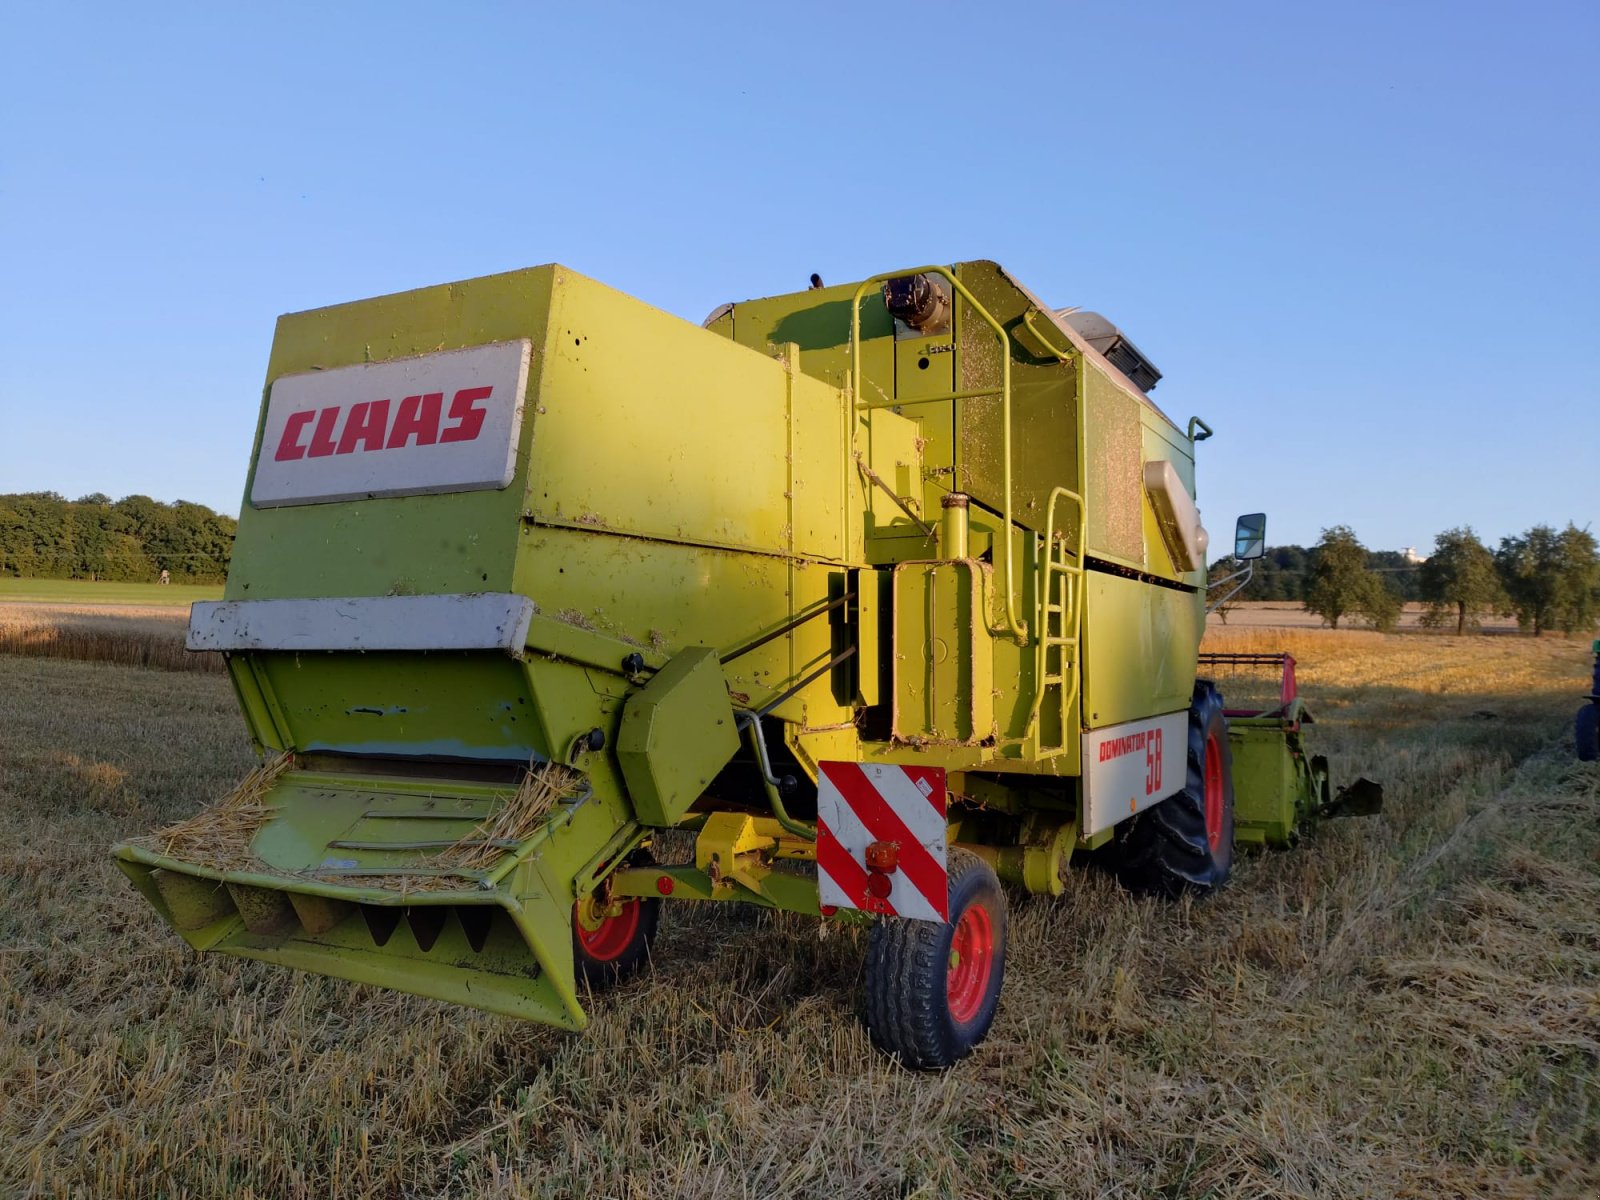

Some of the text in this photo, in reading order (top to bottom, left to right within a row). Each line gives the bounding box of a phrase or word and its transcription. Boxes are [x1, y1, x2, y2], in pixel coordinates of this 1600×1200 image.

[274, 386, 494, 462] CLAAS
[1099, 728, 1162, 795] DOMINATOR 58
